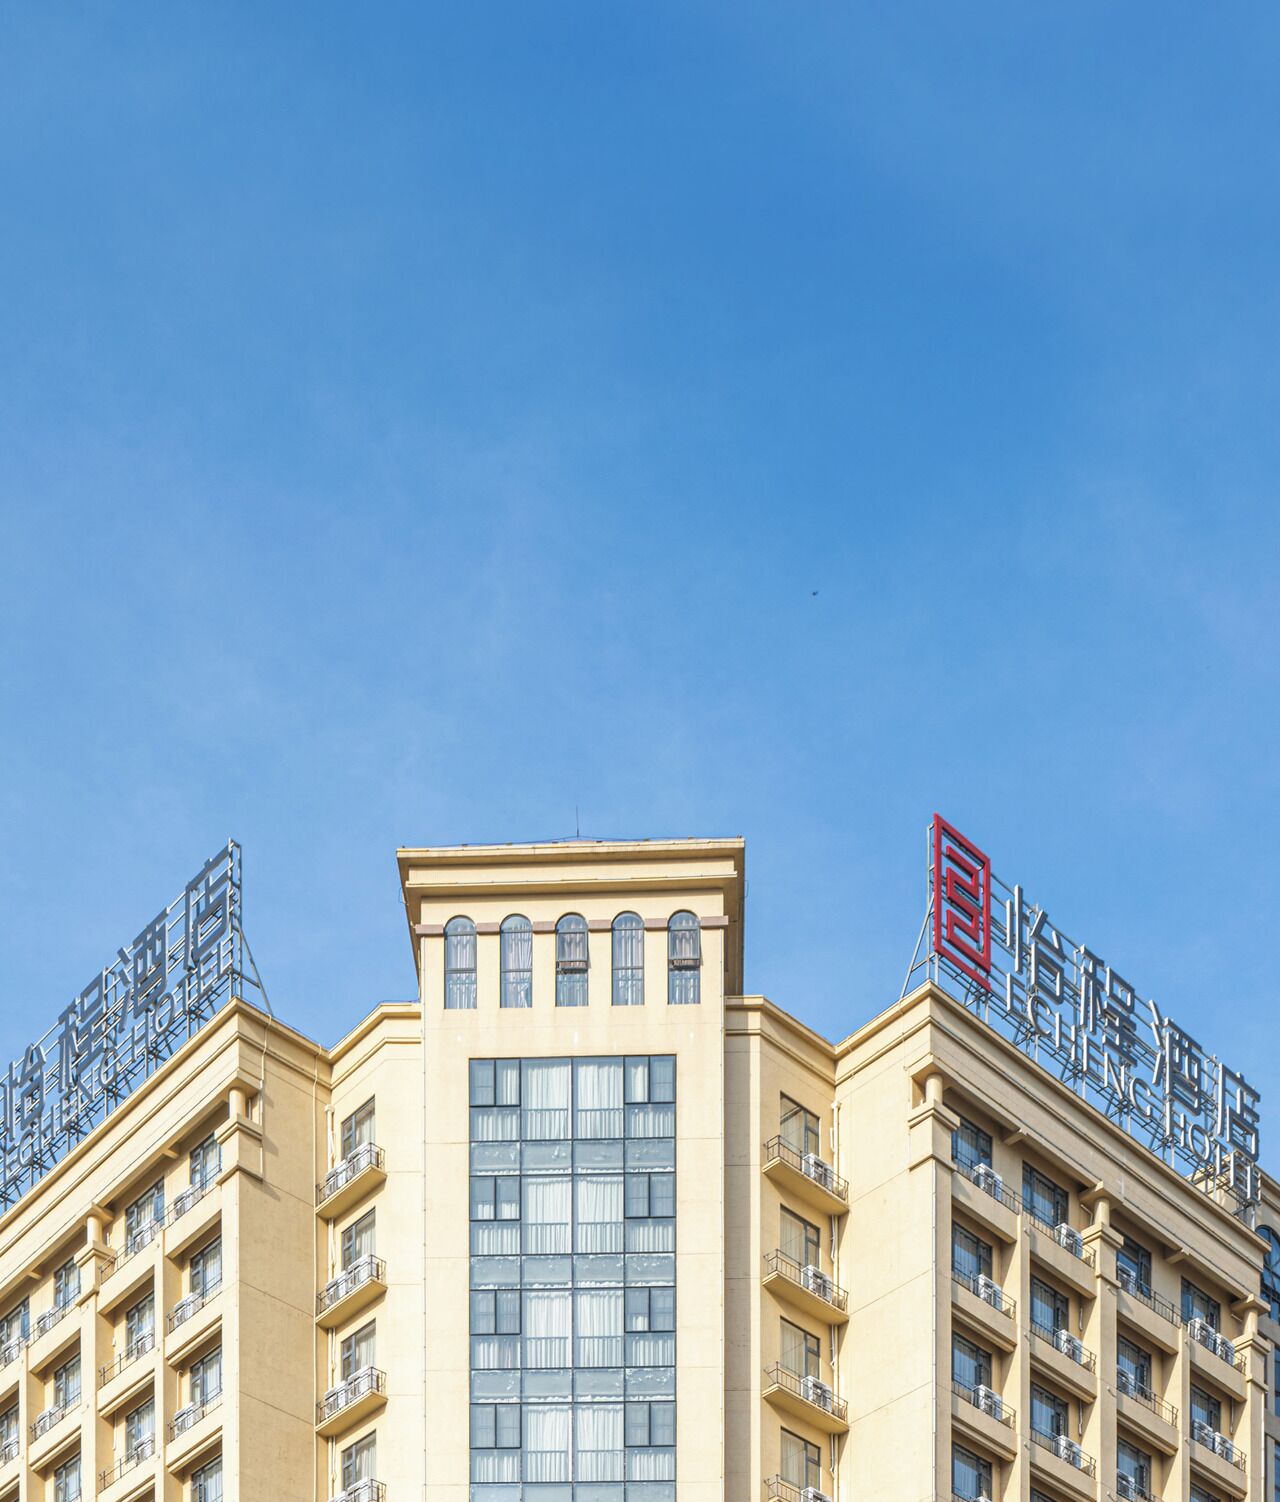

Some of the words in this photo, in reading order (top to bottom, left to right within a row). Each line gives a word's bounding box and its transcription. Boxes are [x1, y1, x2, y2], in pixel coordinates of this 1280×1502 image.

[2, 845, 232, 1142] 怡程酒店
[1005, 884, 1261, 1163] 怡程酒店
[1006, 972, 1154, 1121] ECHENG
[1168, 1098, 1261, 1205] HOTEL
